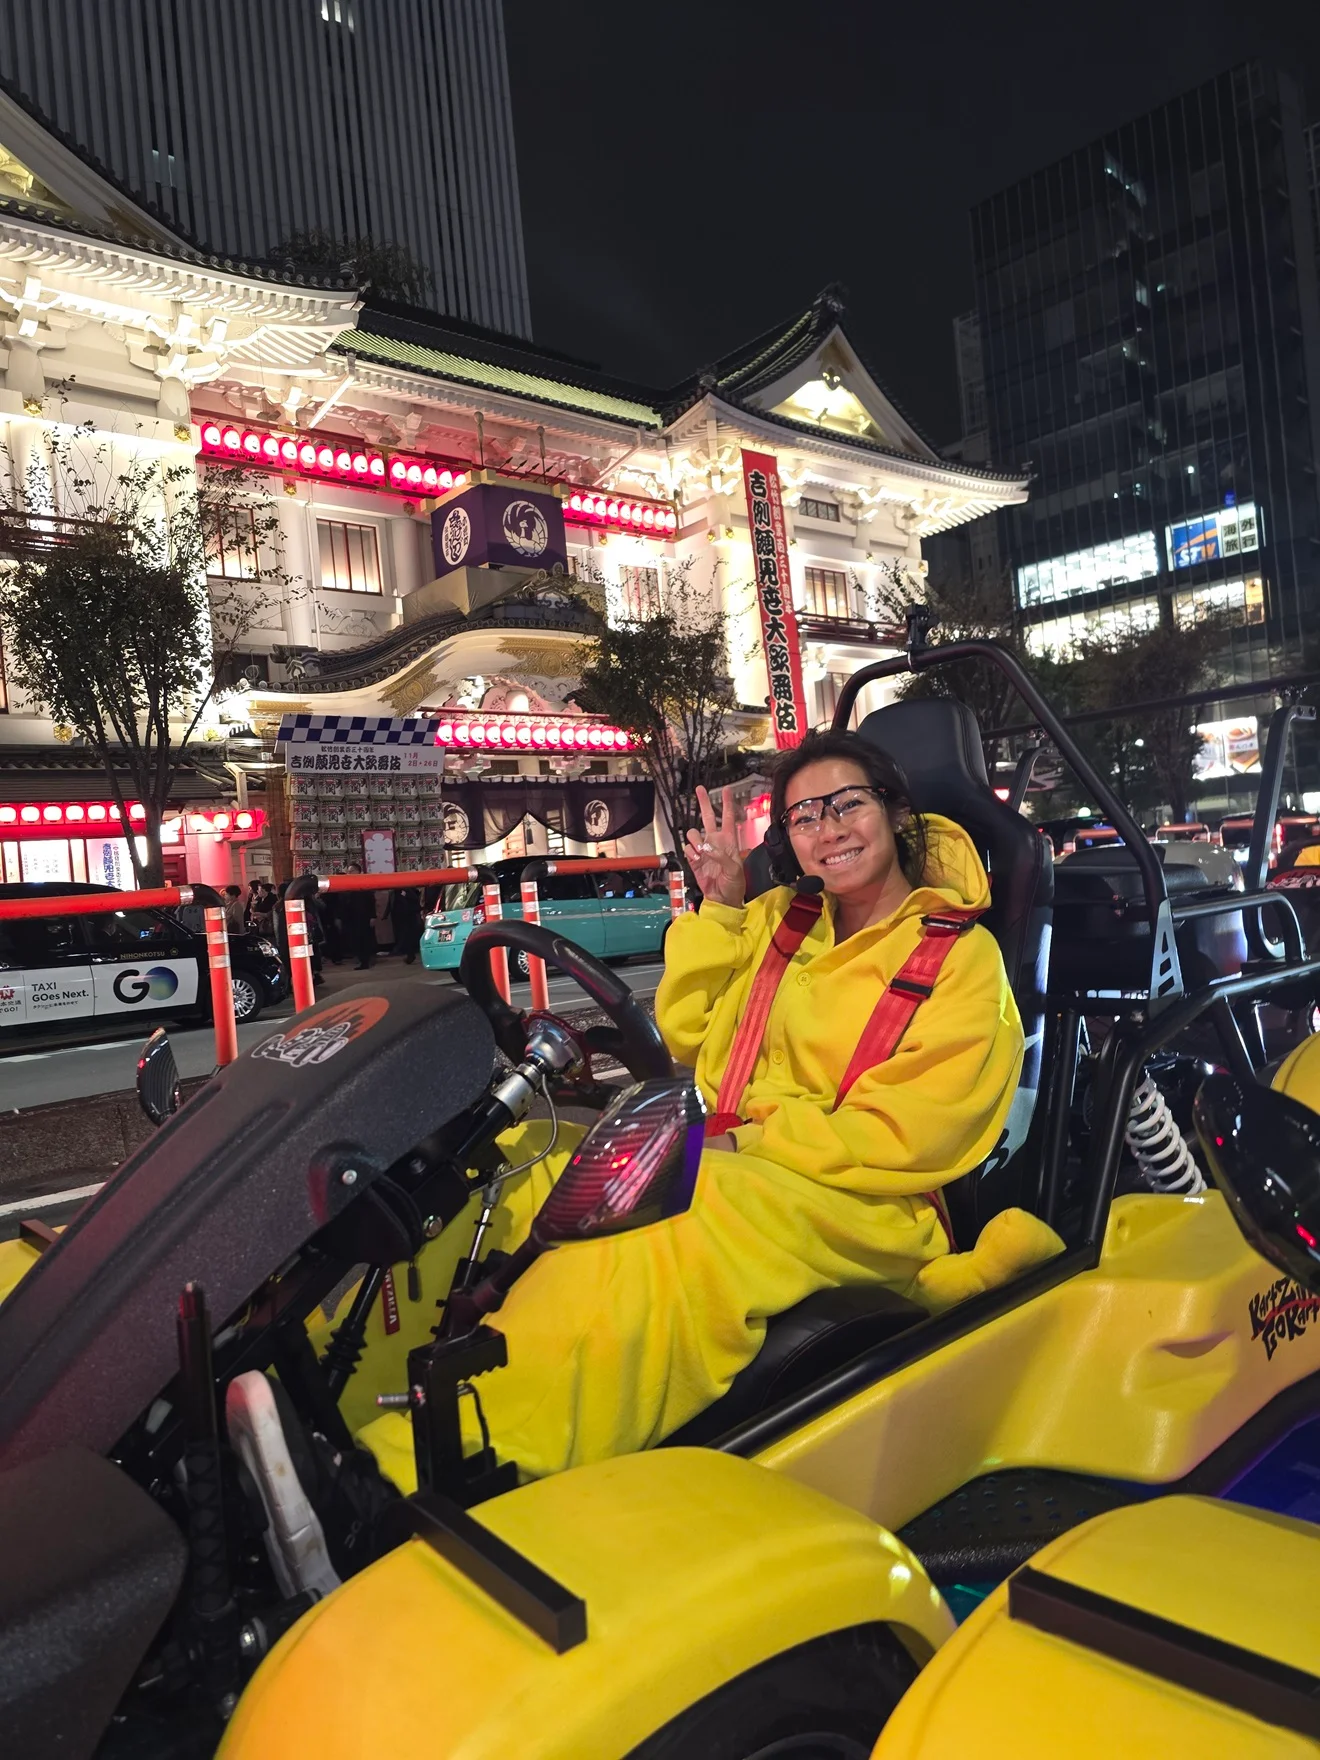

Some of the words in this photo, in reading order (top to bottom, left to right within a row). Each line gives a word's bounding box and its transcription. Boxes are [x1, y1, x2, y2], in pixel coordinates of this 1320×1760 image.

[1223, 517, 1255, 536] 海外
[1225, 534, 1256, 553] 旅行
[120, 951, 165, 960] NIHONKOTSU
[31, 982, 57, 991] TAXI
[32, 993, 60, 1002] GOes
[62, 989, 89, 999] Next.
